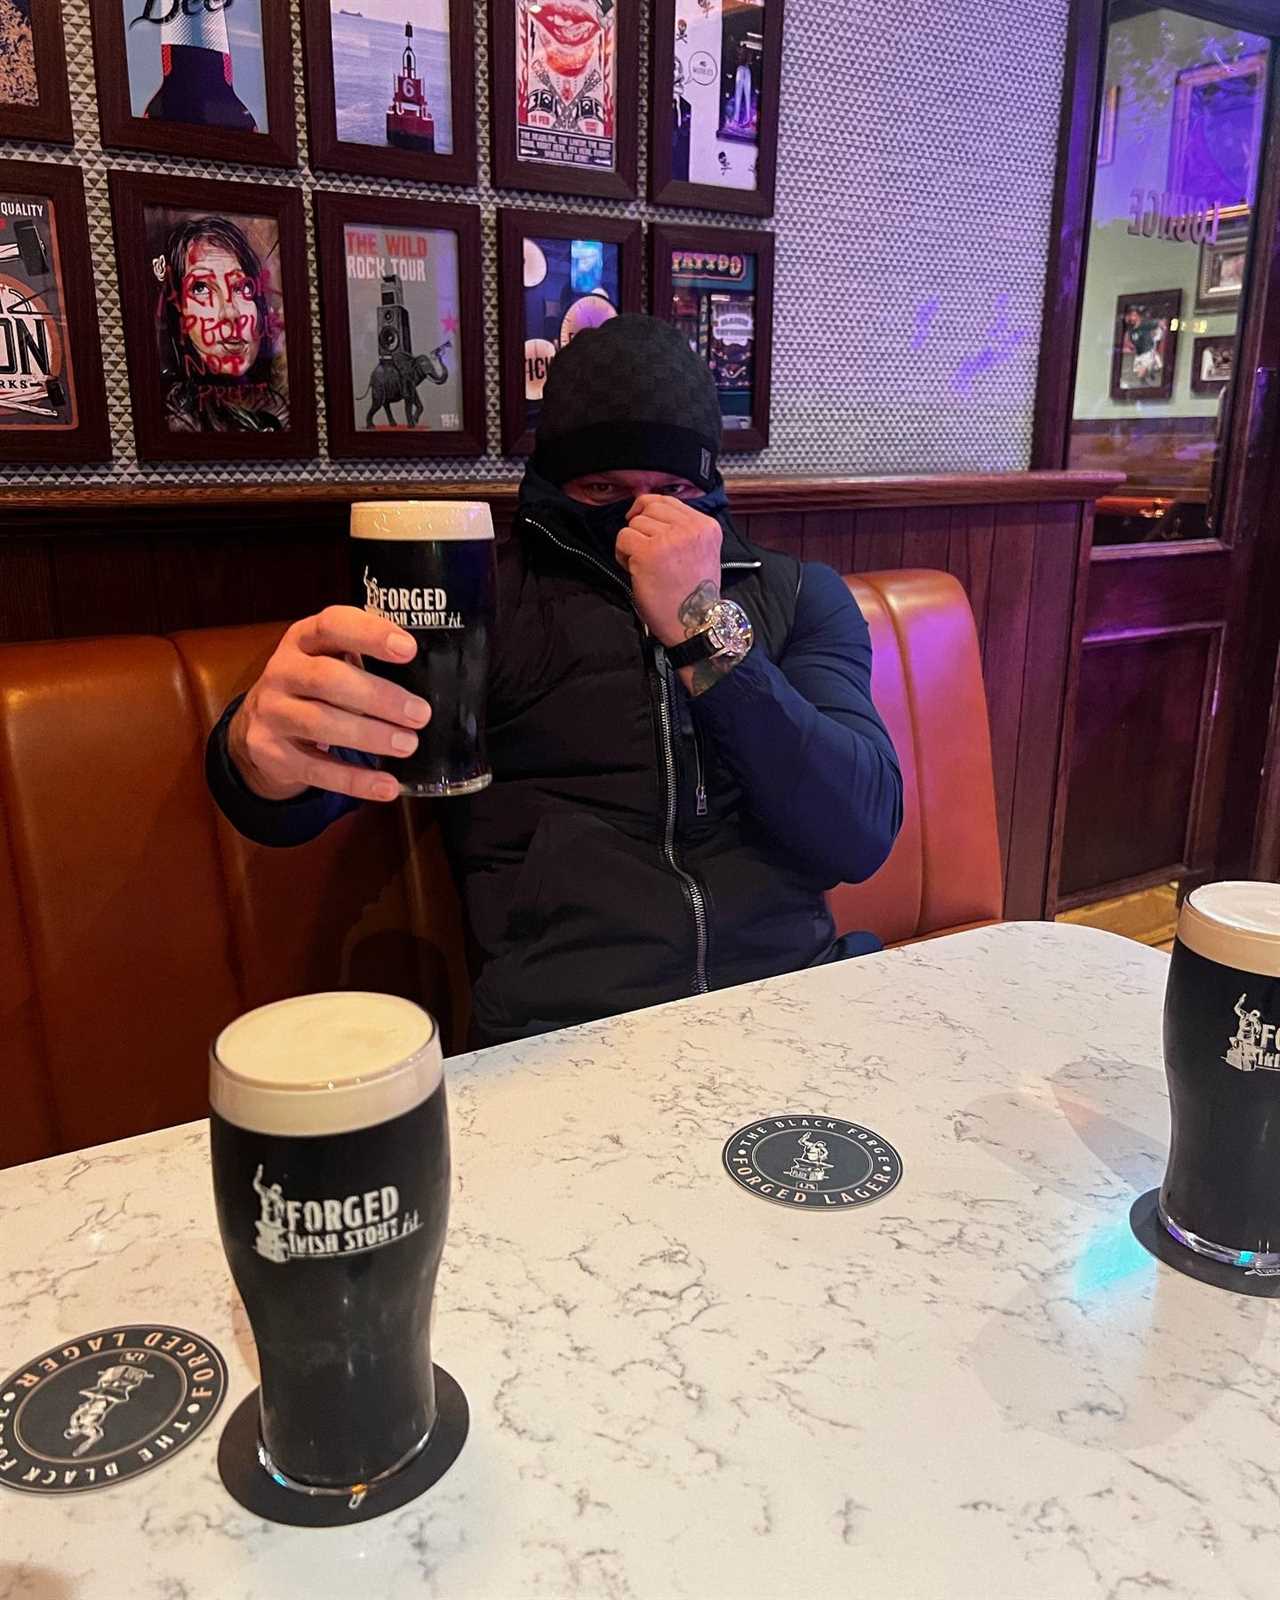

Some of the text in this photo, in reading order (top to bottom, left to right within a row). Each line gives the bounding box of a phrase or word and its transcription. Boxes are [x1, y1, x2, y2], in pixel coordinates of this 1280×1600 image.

[403, 79, 415, 97] 6
[1, 202, 43, 217] QUALITY
[346, 231, 428, 257] THE WILD
[346, 256, 427, 281] ROCK TOUR
[379, 587, 448, 611] FORGED
[410, 611, 446, 626] STOUT
[740, 1118, 890, 1163] THE BLACK FORGE
[733, 1157, 892, 1205] FORGED LAGER
[287, 1185, 400, 1232] FORGED
[287, 1231, 339, 1254] IRISH
[343, 1217, 399, 1250] STOUT
[14, 1332, 215, 1399] FORGED LAGER
[137, 1420, 192, 1462] THE
[21, 1461, 120, 1485] BLACK
